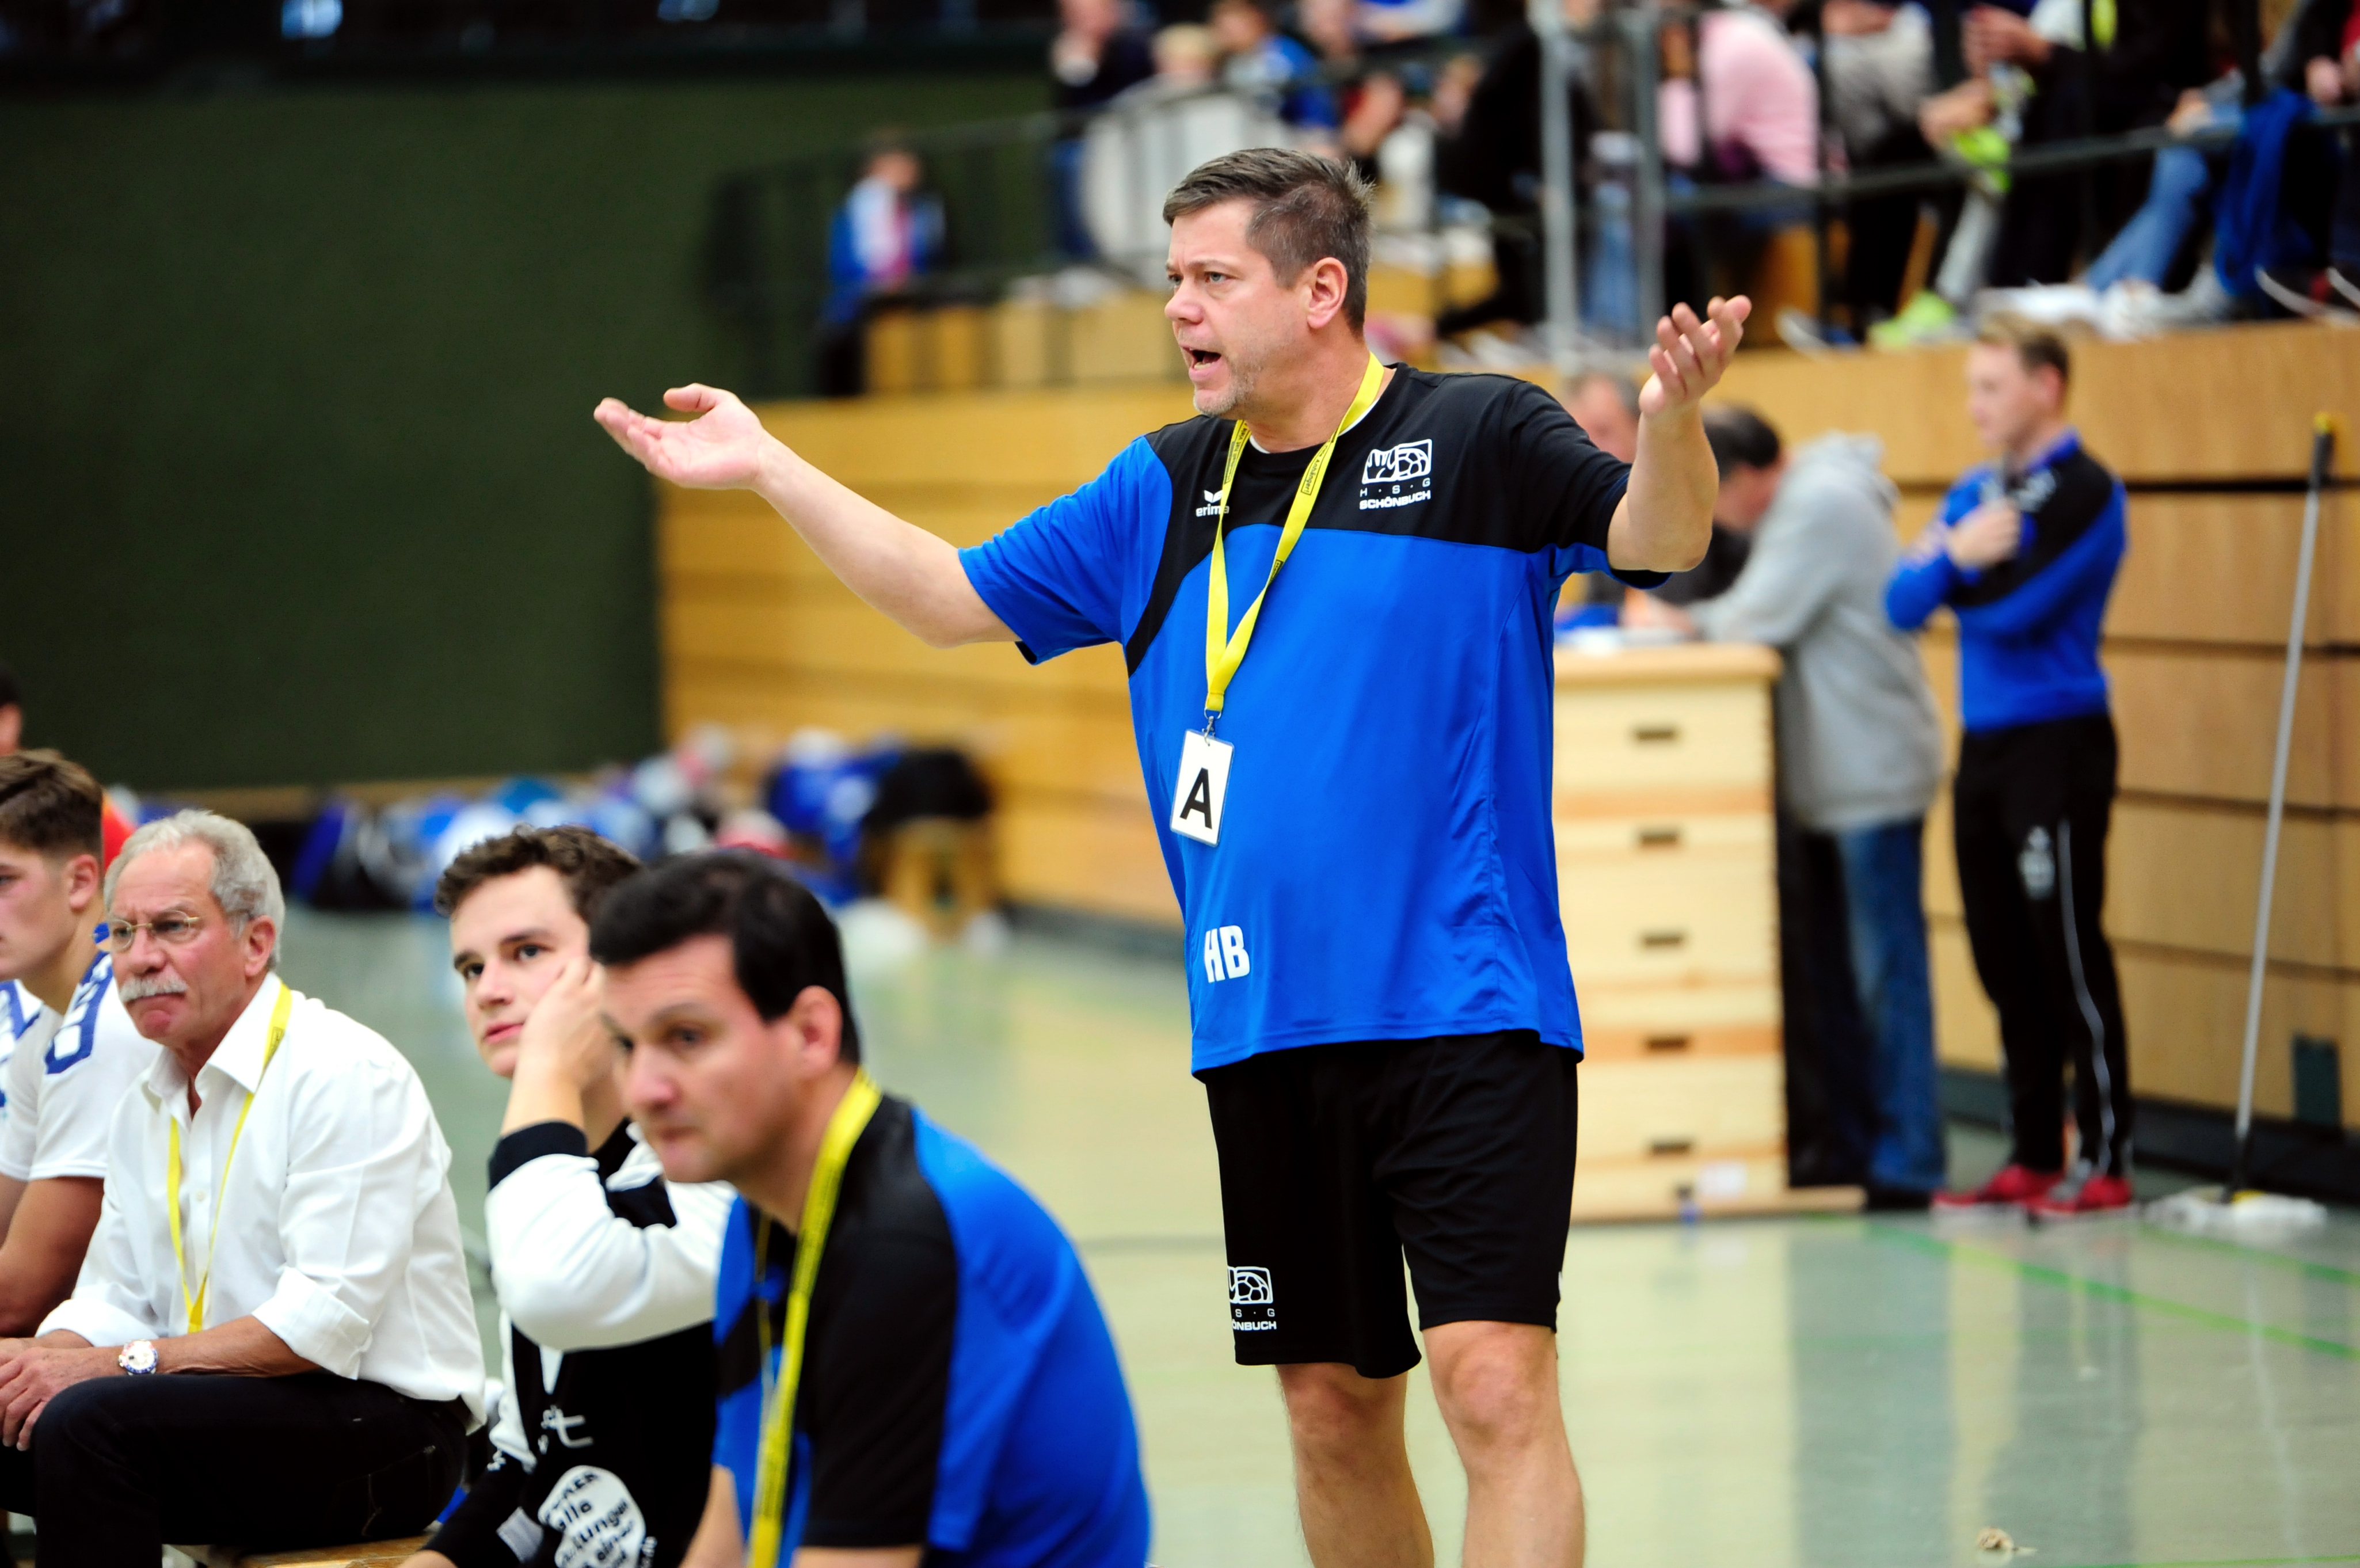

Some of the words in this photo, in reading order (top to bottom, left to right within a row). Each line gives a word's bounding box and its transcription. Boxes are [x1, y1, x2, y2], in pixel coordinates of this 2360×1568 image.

[1196, 503, 1230, 517] erima
[1359, 490, 1432, 510] SCHÖNBUCH
[1179, 767, 1213, 829] A
[1204, 924, 1250, 984] HB
[1232, 1318, 1277, 1331] ÖNBUCH
